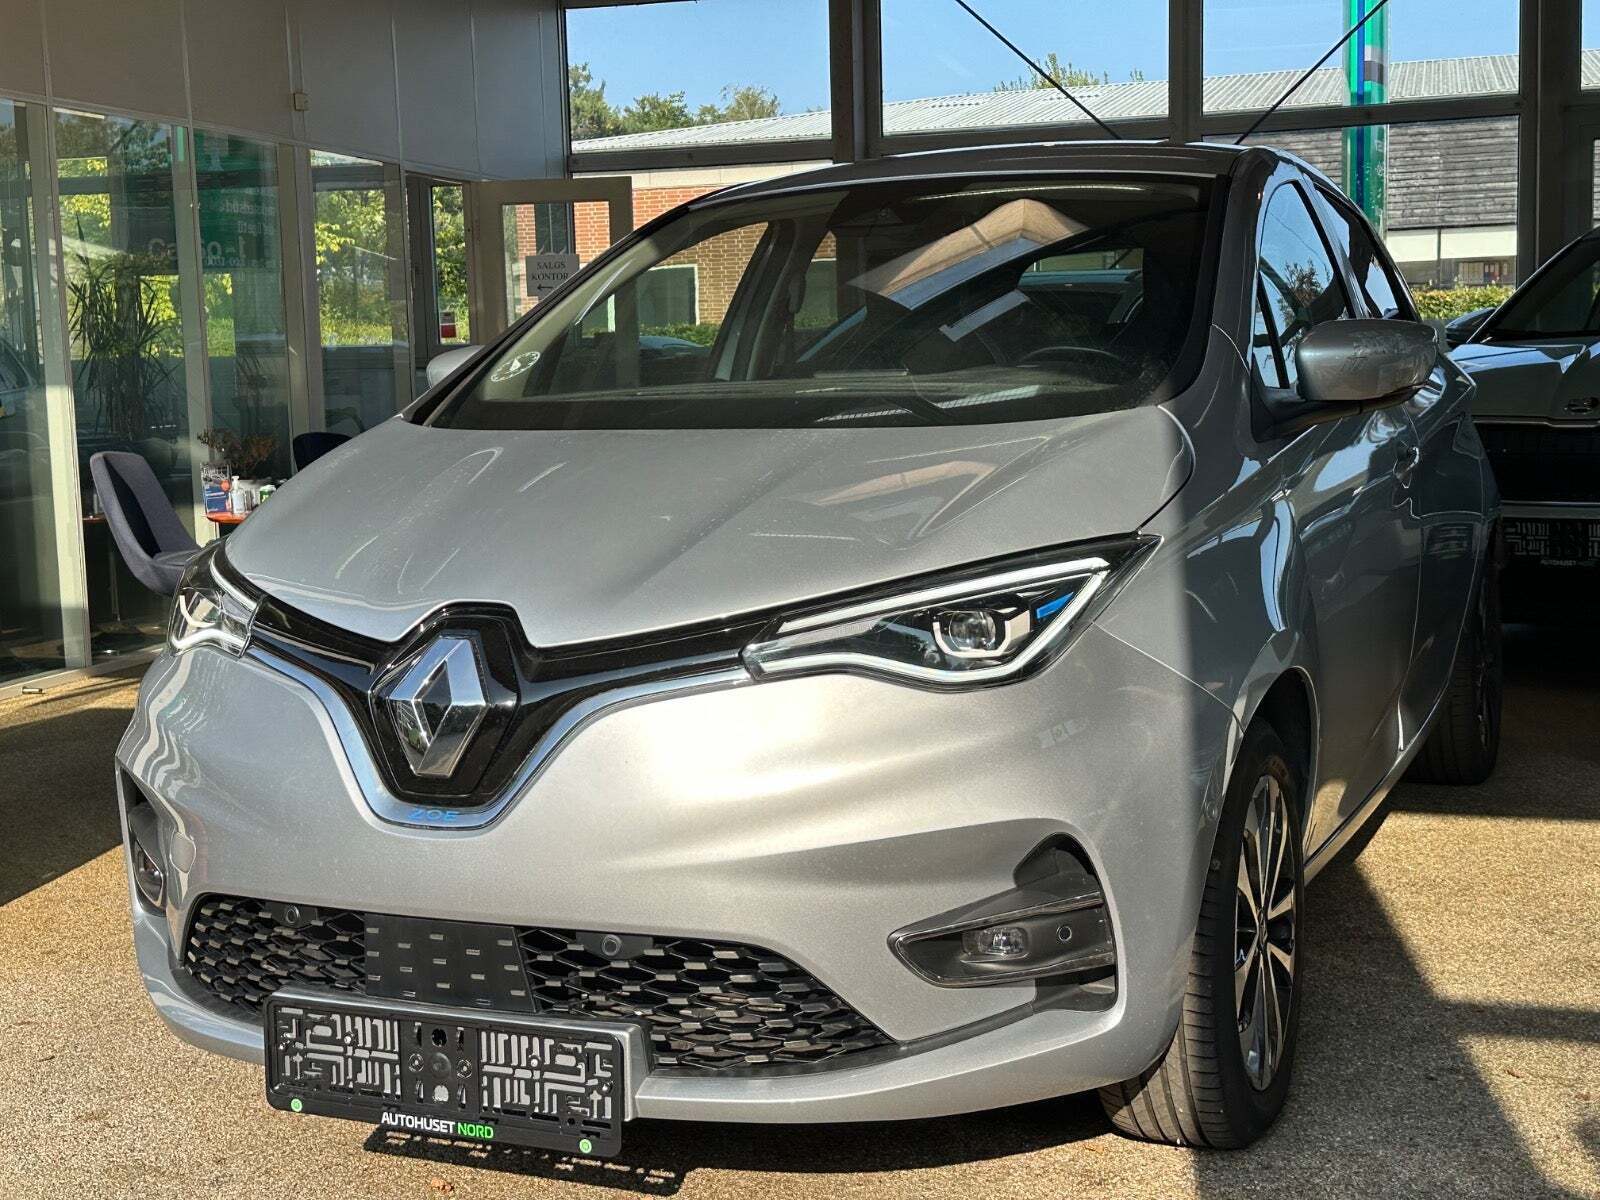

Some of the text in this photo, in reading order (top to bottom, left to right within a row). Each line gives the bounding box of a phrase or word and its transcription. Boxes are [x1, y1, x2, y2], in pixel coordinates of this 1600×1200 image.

[537, 261, 566, 271] SALGS
[531, 272, 569, 281] KONTOR
[407, 808, 461, 821] ZOE
[381, 1111, 494, 1139] AUTOHUSET NORD
